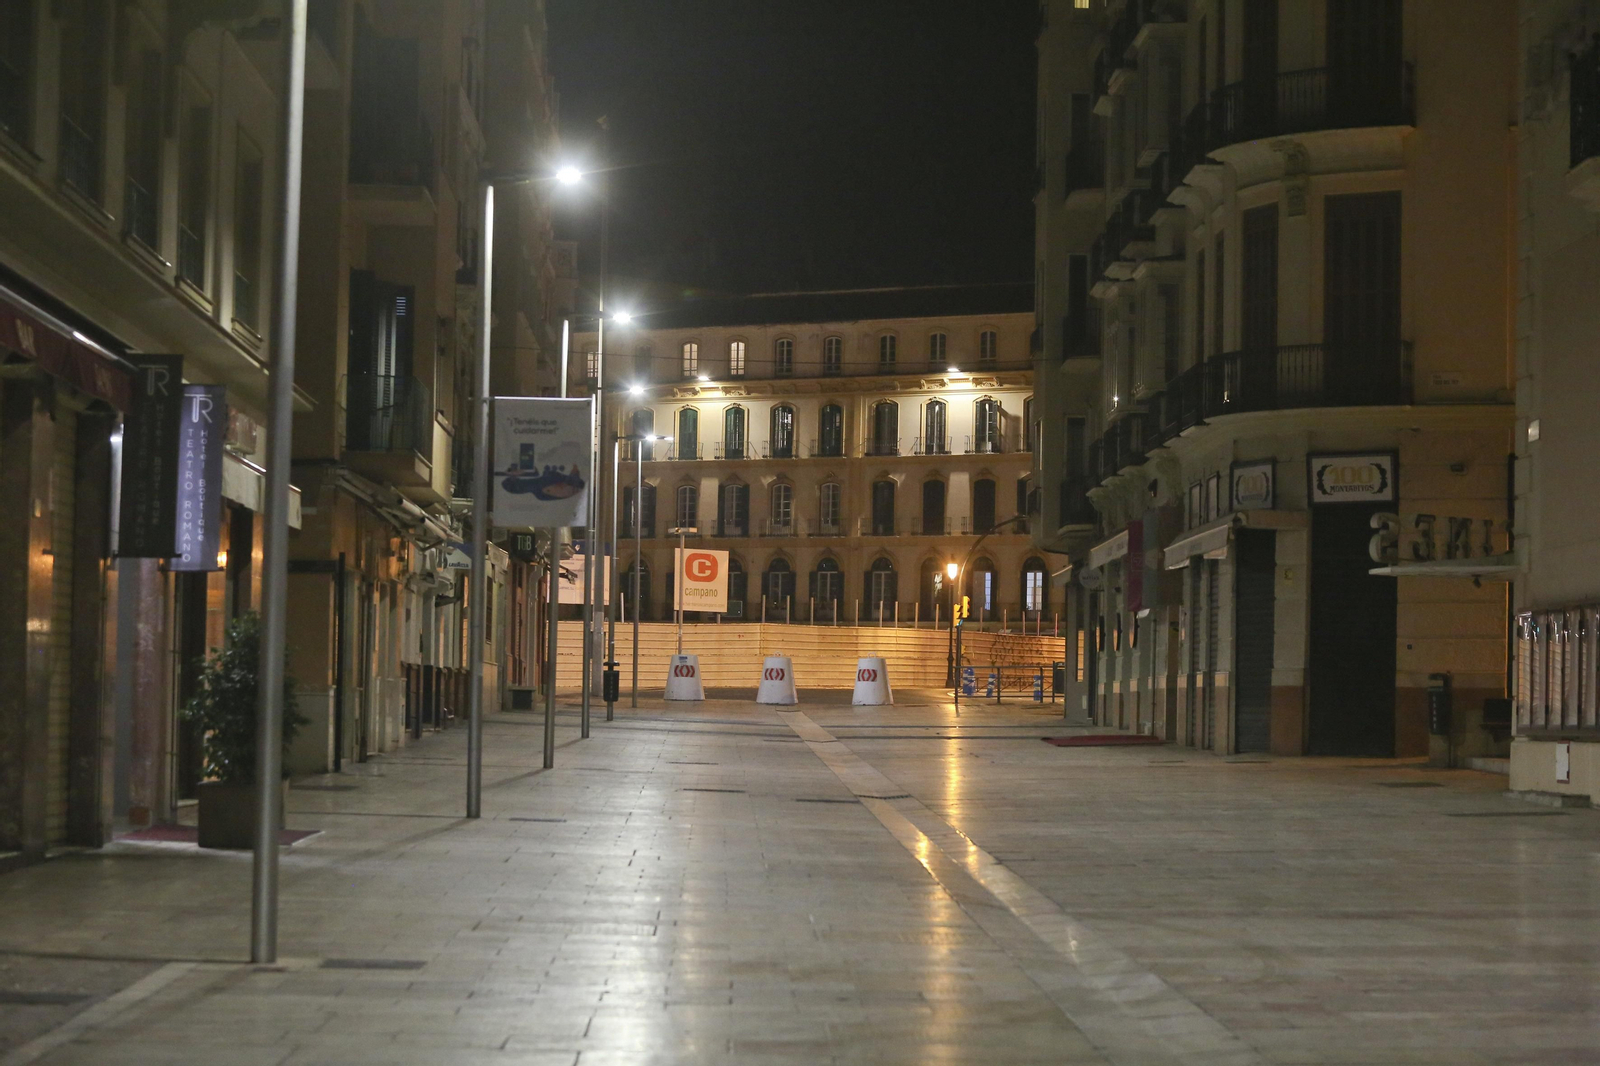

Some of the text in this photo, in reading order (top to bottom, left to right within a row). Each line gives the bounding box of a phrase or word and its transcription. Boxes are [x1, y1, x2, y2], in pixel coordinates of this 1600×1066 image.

[184, 394, 213, 424] TR
[197, 429, 208, 541] Hotel Boutique
[1329, 466, 1375, 485] 100
[182, 428, 194, 562] TEATRO ROMANO
[516, 534, 532, 551] TGB
[684, 587, 718, 599] campano
